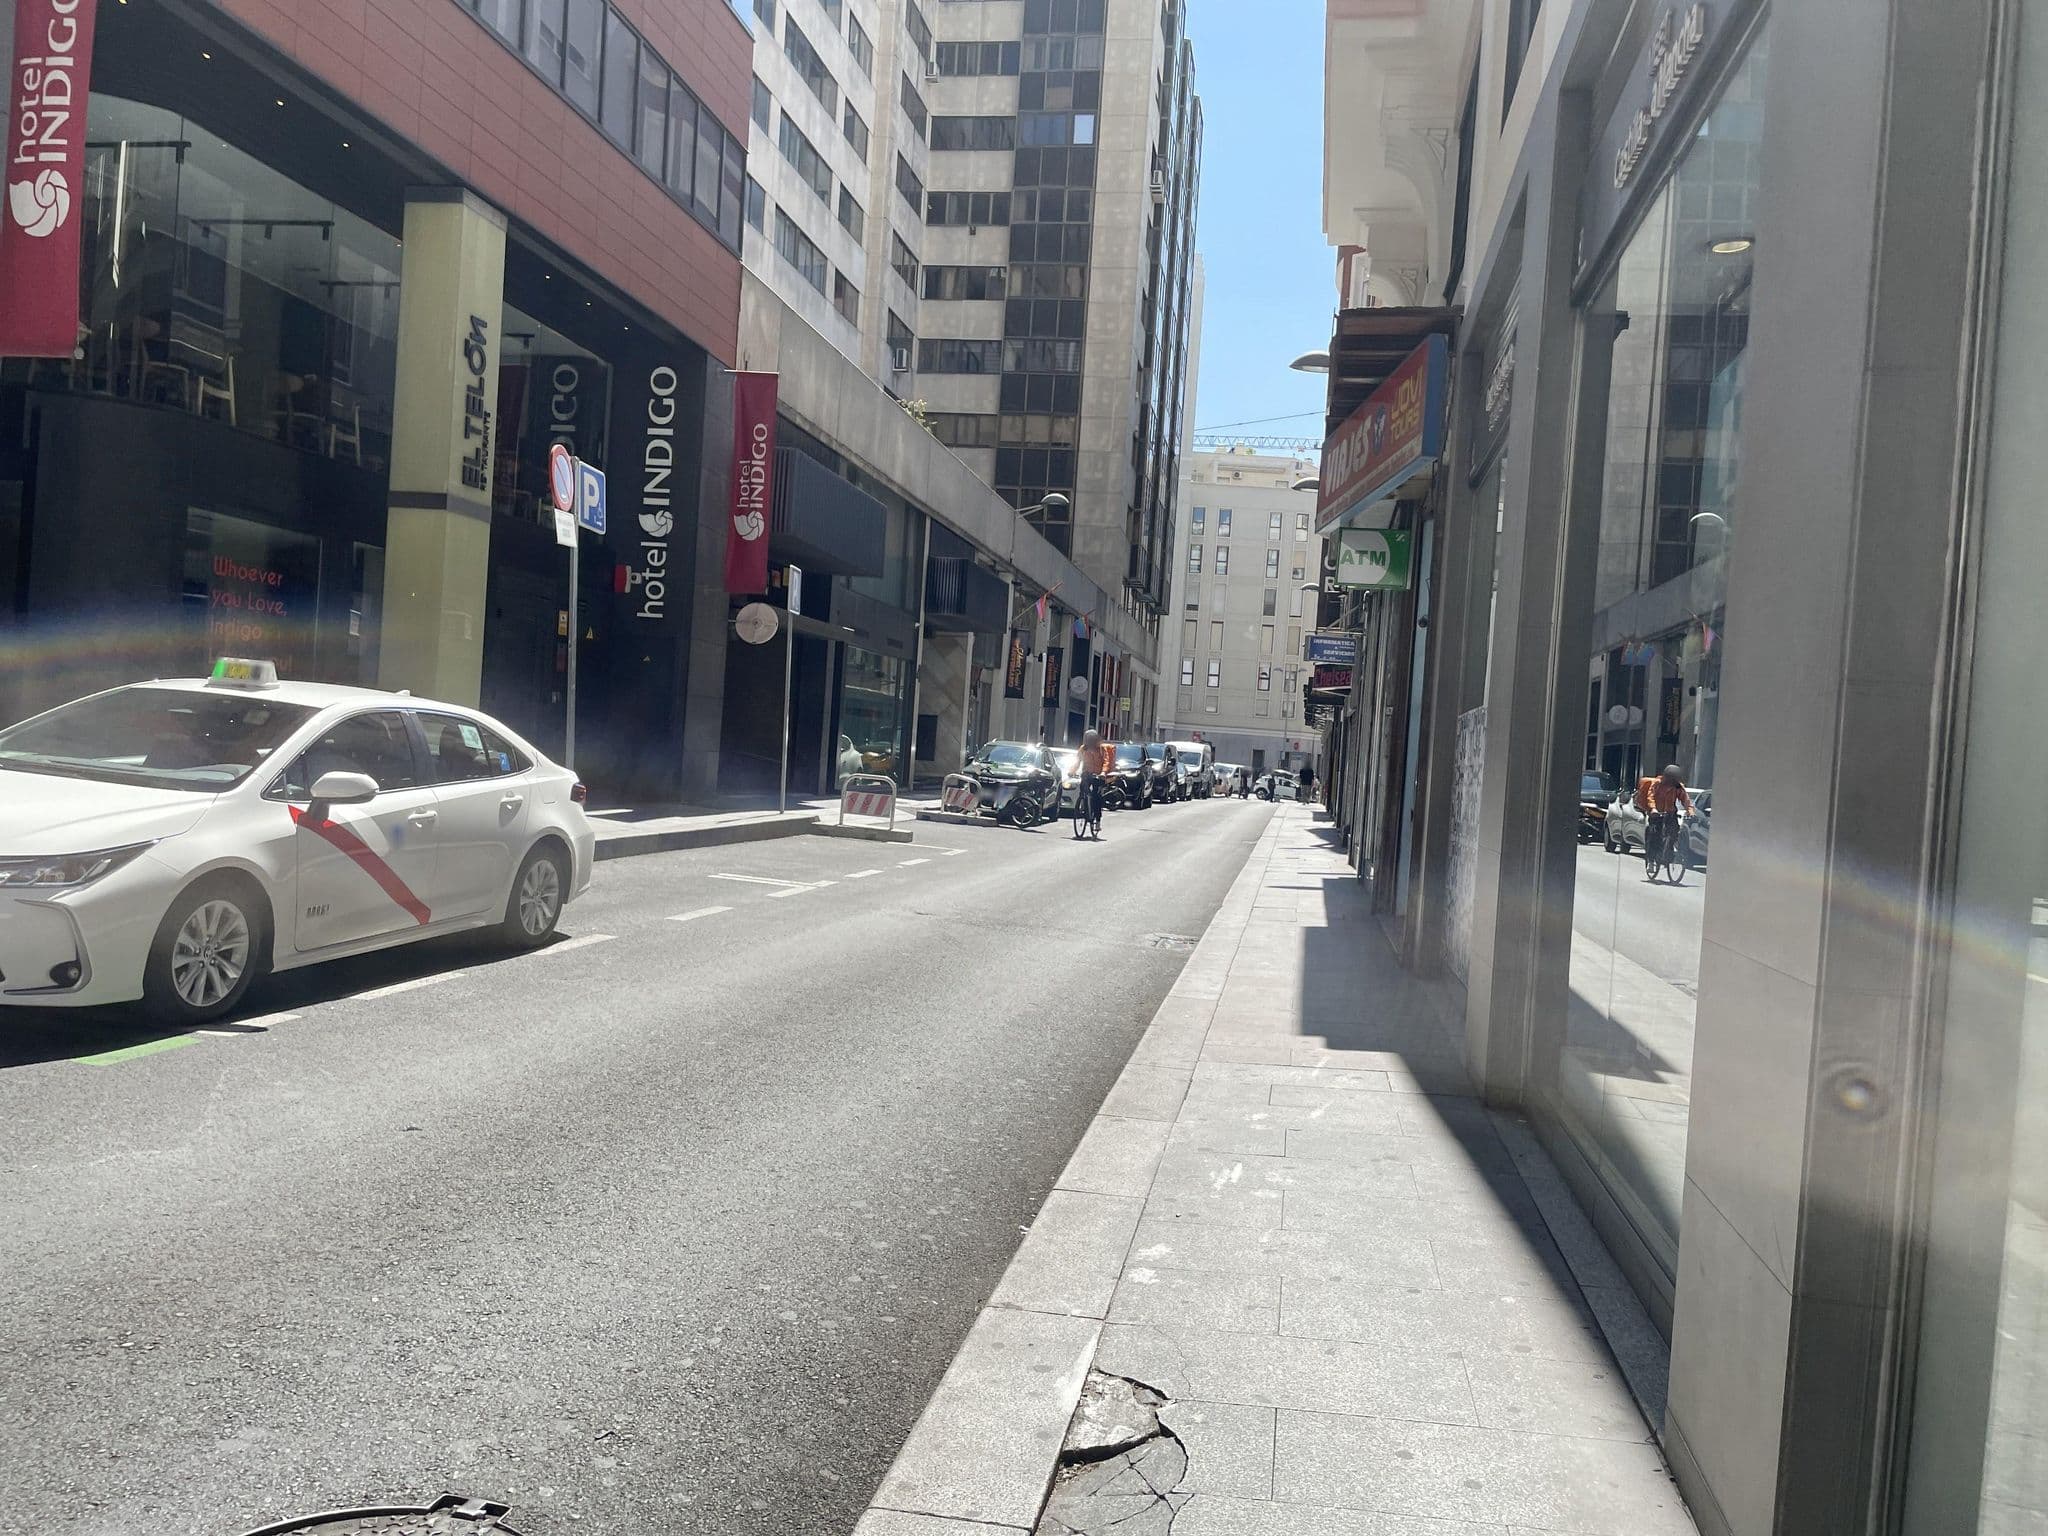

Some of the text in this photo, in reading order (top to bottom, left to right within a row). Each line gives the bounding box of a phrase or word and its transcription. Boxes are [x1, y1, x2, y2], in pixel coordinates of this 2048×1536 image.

[14, 56, 42, 163] hotel
[462, 447, 481, 490] EL
[480, 411, 491, 491] RETAURANTE
[750, 423, 768, 508] INDIGO
[583, 471, 600, 520] P
[637, 366, 677, 618] hotel INDIGO
[736, 460, 751, 508] hotel
[214, 556, 283, 586] Whoever
[1341, 549, 1387, 566] ATM
[211, 588, 242, 609] you
[209, 614, 263, 641] Indigo
